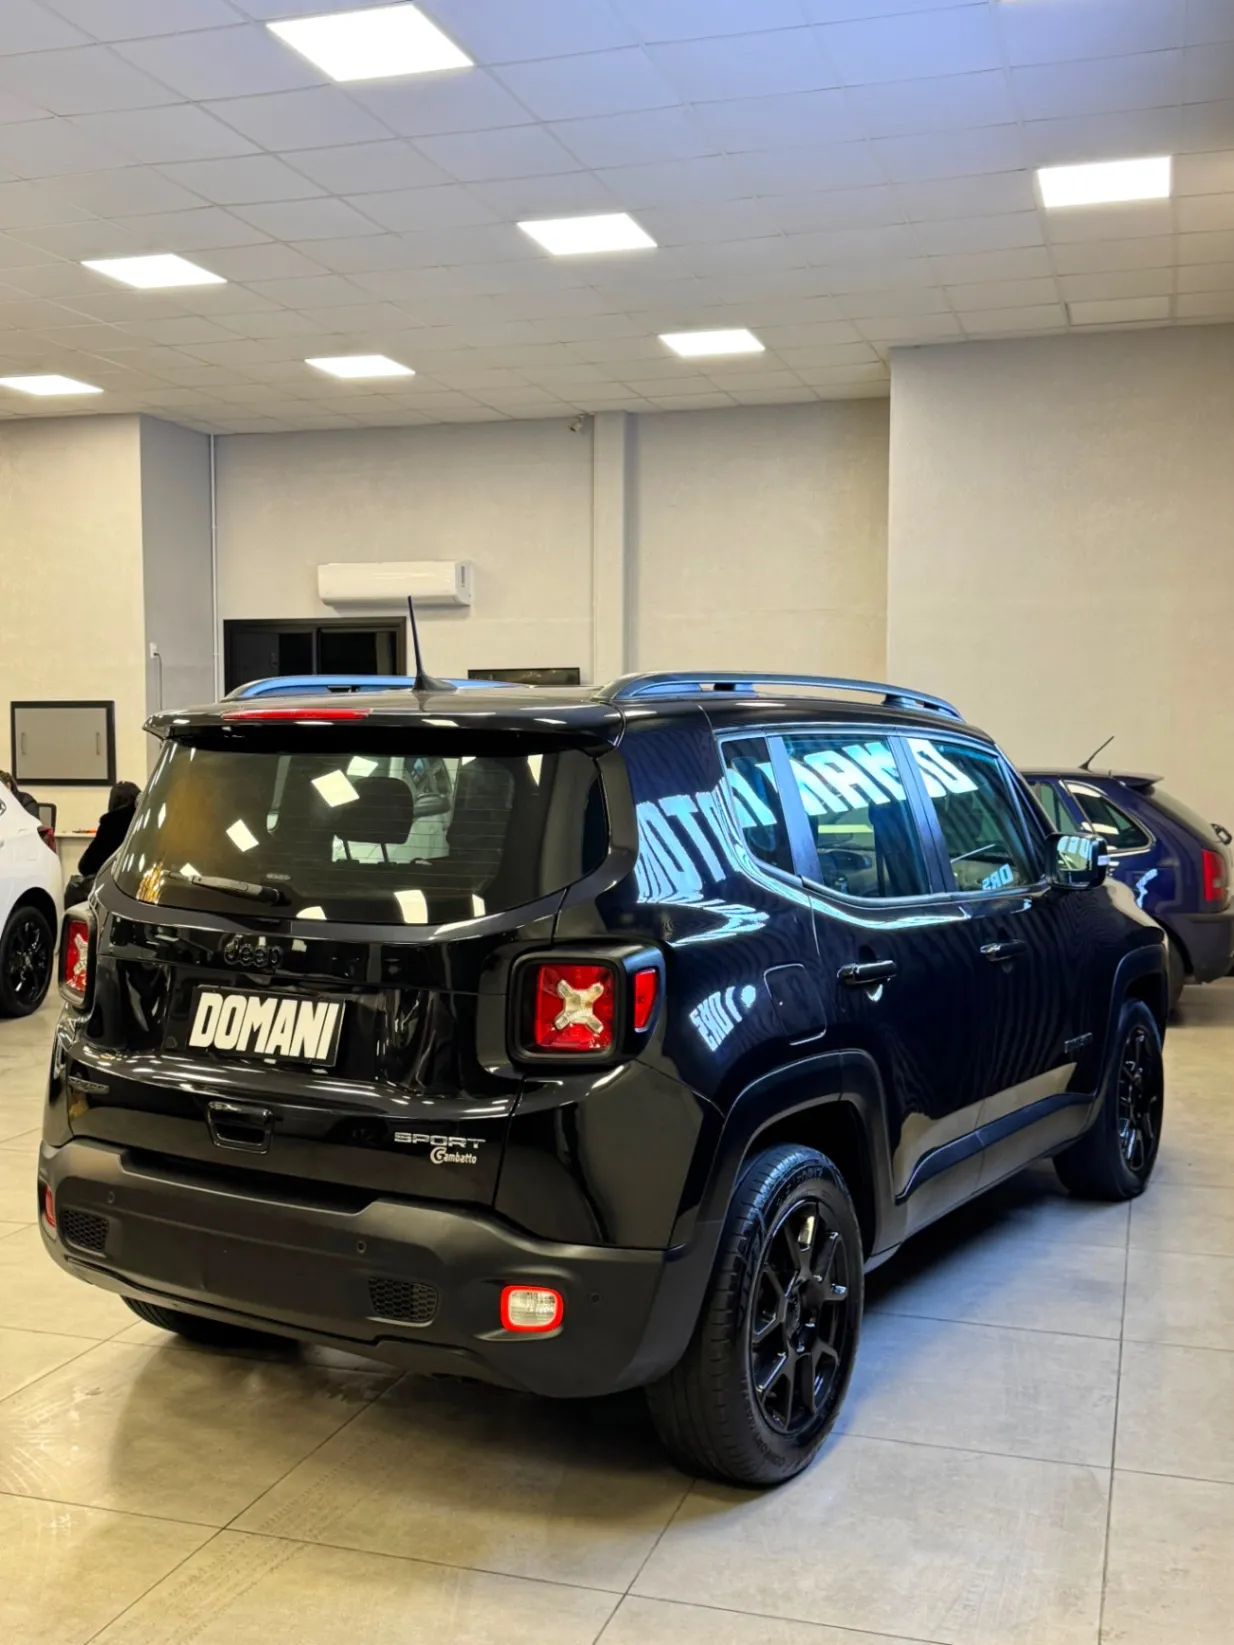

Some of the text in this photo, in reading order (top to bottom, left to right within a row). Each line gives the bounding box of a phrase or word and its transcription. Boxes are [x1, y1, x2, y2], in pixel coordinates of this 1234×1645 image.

[189, 992, 339, 1060] DOMANI
[394, 1132, 486, 1149] SPORT
[430, 1146, 477, 1165] Gambatto
